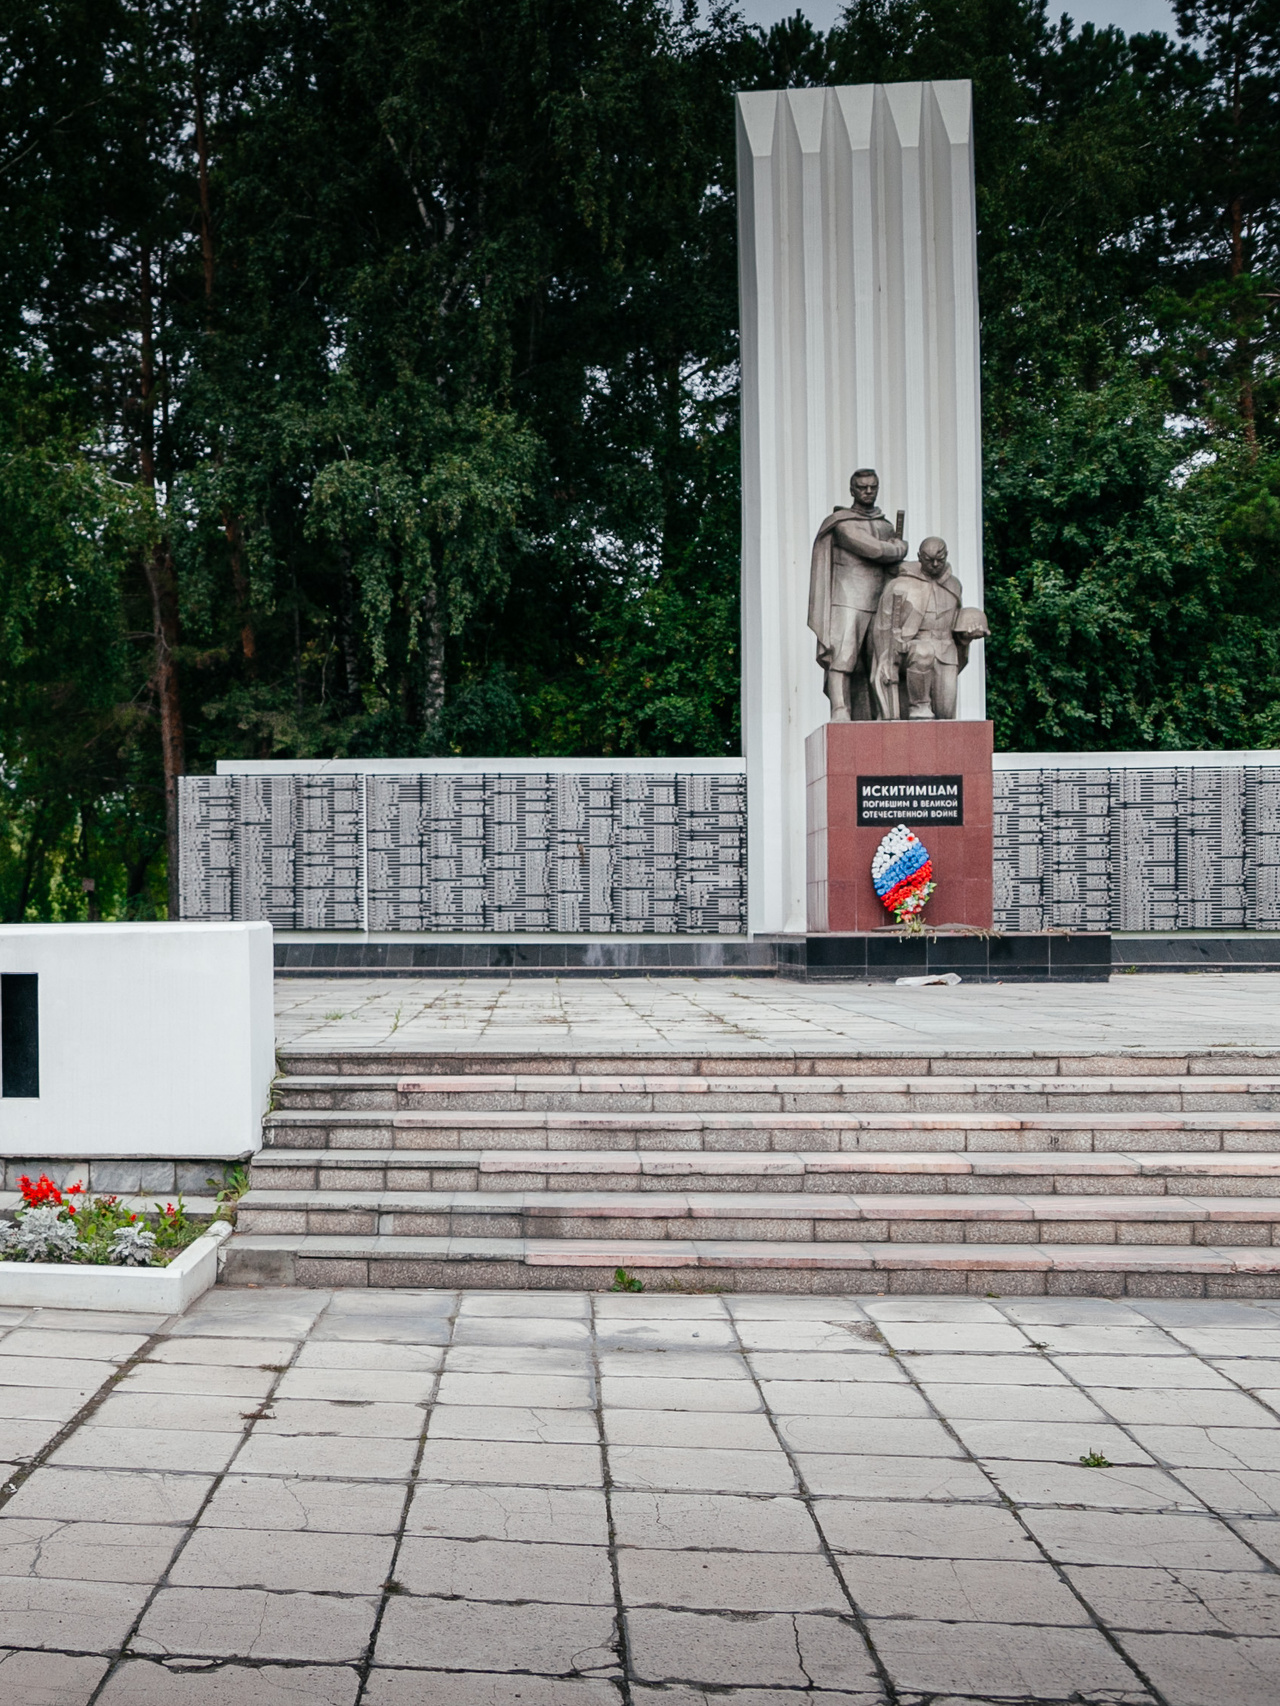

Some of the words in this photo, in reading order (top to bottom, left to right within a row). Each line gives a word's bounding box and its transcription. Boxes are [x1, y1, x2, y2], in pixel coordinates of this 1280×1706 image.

[862, 785, 958, 797] ИСКИТИМЦАМ
[863, 800, 910, 808] ПОГИБШИМ
[912, 800, 918, 808] В
[920, 799, 958, 808] ВЕЛИКОЙ
[862, 809, 928, 818] ОТЕЧЕСТВЕННОЙ
[930, 809, 958, 818] ВОЙНЕ
